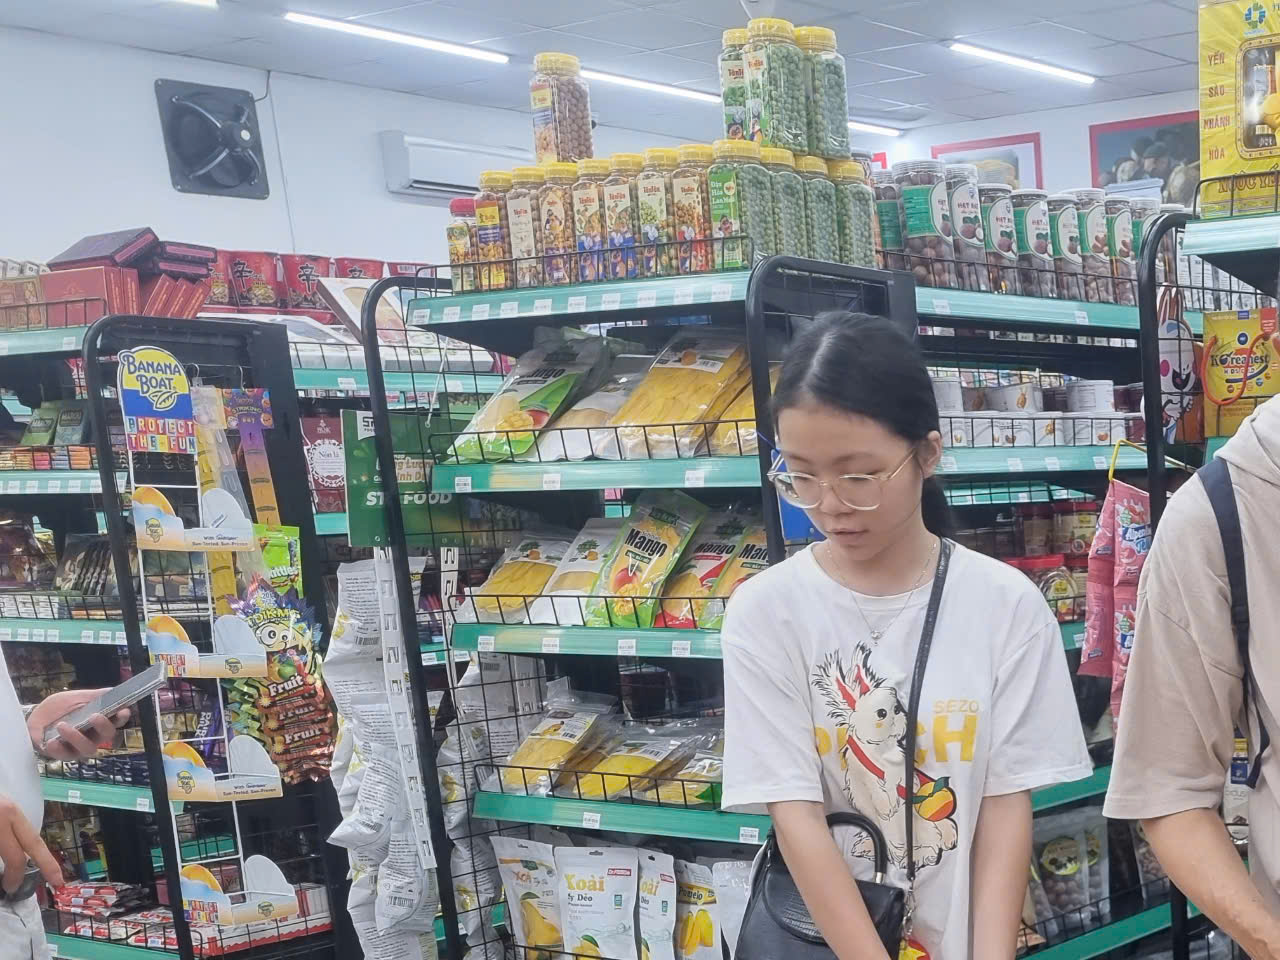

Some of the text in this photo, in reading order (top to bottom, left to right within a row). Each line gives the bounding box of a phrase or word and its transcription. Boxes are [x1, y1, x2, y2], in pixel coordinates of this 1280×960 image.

[297, 262, 320, 294] 辛
[120, 353, 182, 376] BANANA
[136, 374, 174, 395] BOAT
[128, 417, 193, 434] PROTECT
[170, 436, 196, 451] FUN
[403, 491, 452, 505] FOOD
[625, 528, 668, 558] Mango
[268, 674, 304, 697] Fruit
[284, 728, 322, 744] Fruit
[564, 873, 605, 892] Xoài
[640, 876, 660, 897] oài
